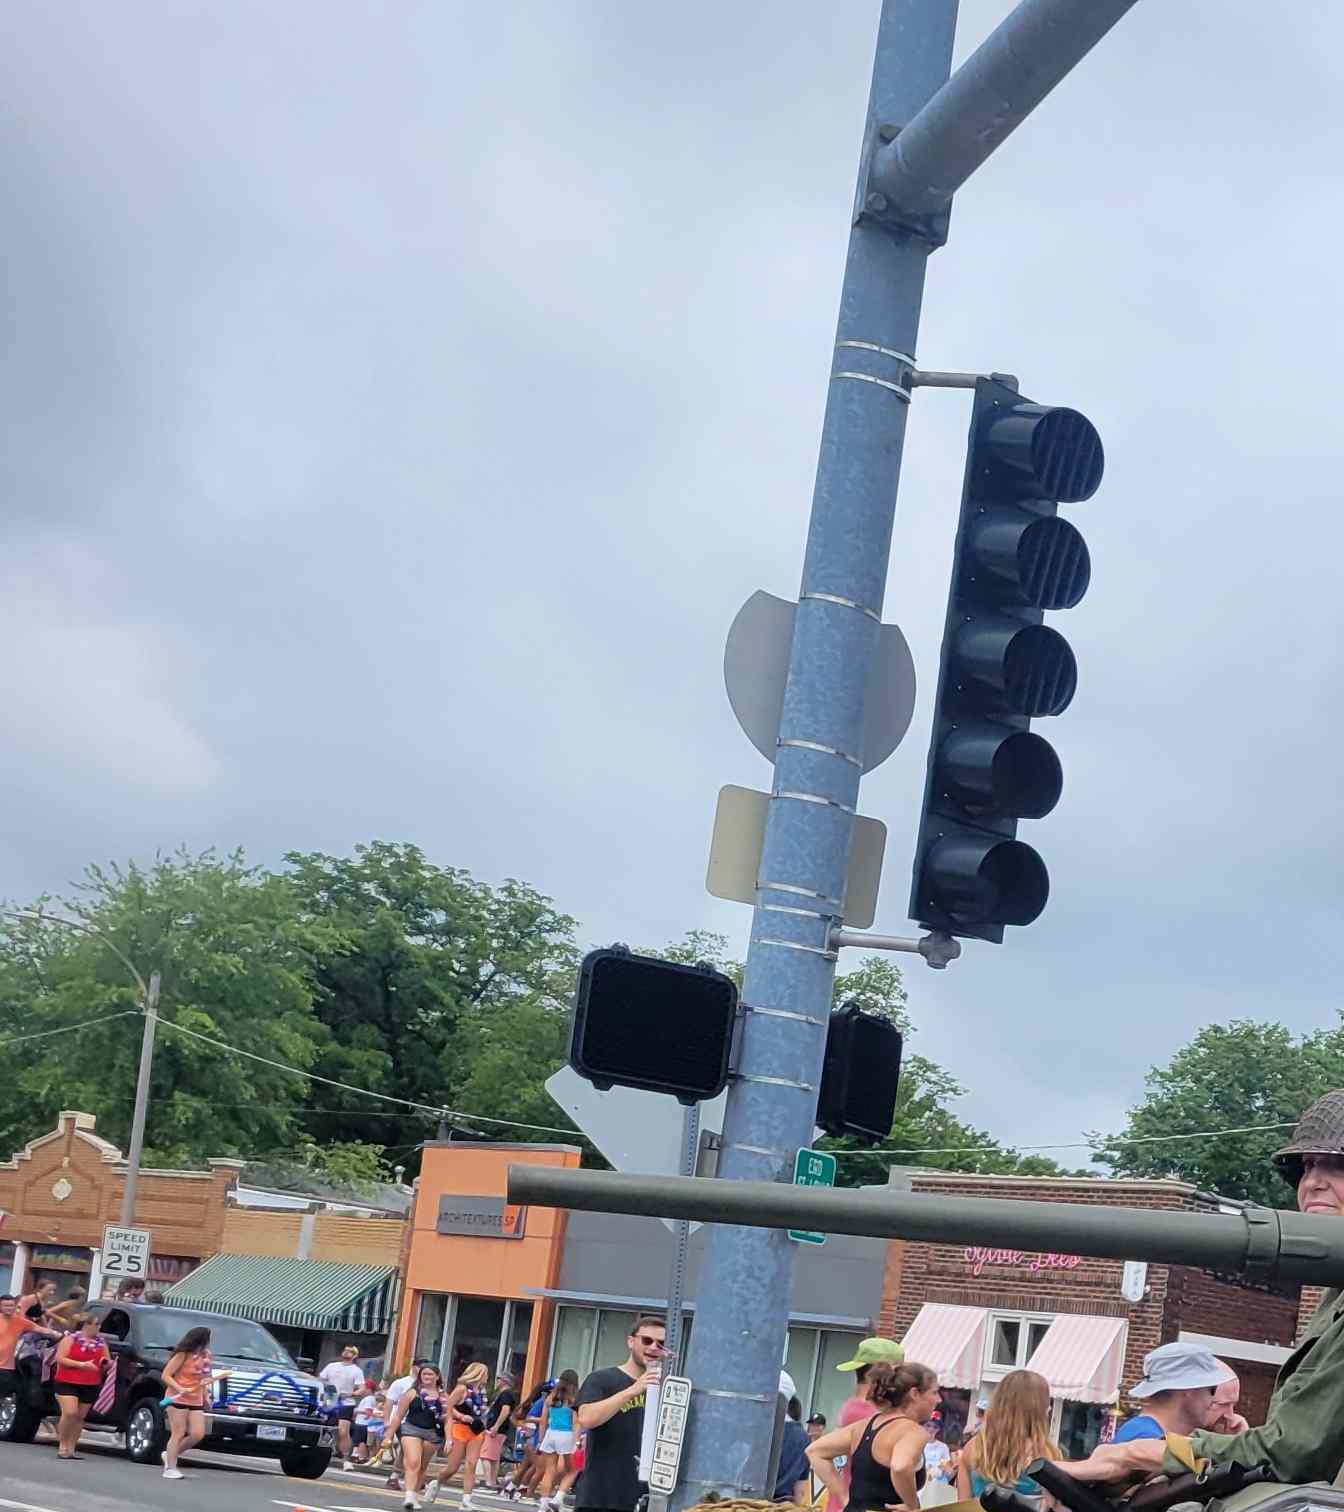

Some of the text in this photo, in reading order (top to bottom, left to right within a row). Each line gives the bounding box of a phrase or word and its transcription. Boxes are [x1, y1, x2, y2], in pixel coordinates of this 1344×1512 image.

[108, 1231, 146, 1243] SPEED
[111, 1242, 141, 1253] LIMIT
[105, 1252, 142, 1273] 25
